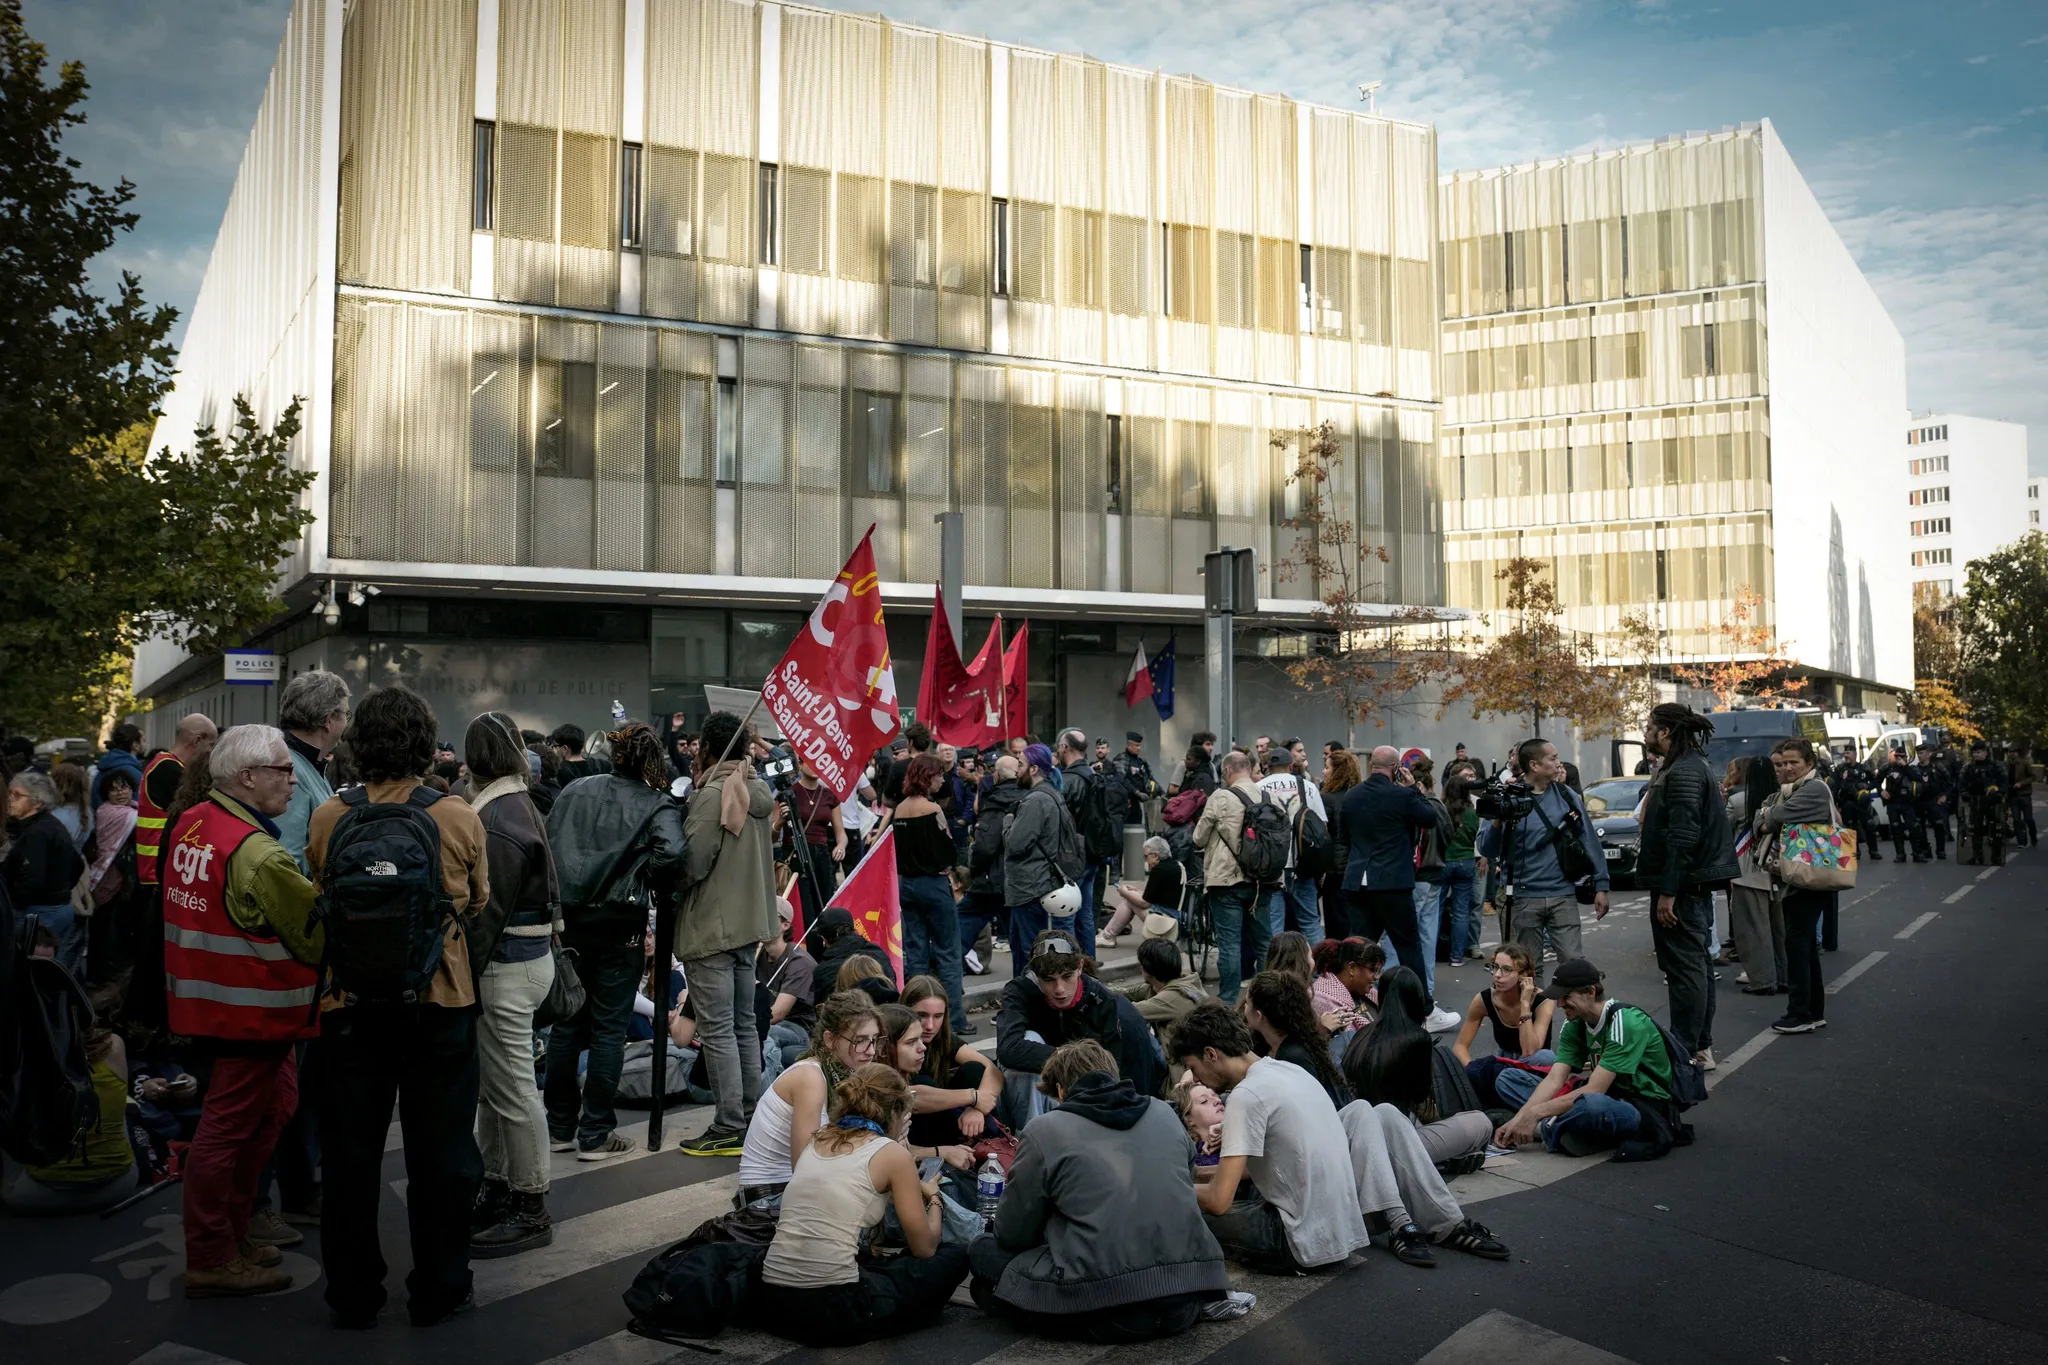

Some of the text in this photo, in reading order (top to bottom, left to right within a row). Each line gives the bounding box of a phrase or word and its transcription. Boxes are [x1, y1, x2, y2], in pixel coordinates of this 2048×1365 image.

[235, 660, 275, 668] POLICE
[538, 680, 558, 695] DE
[567, 681, 627, 696] POLICE
[781, 660, 854, 761] Saint-Denis
[179, 819, 216, 850] la
[173, 843, 214, 885] cgt
